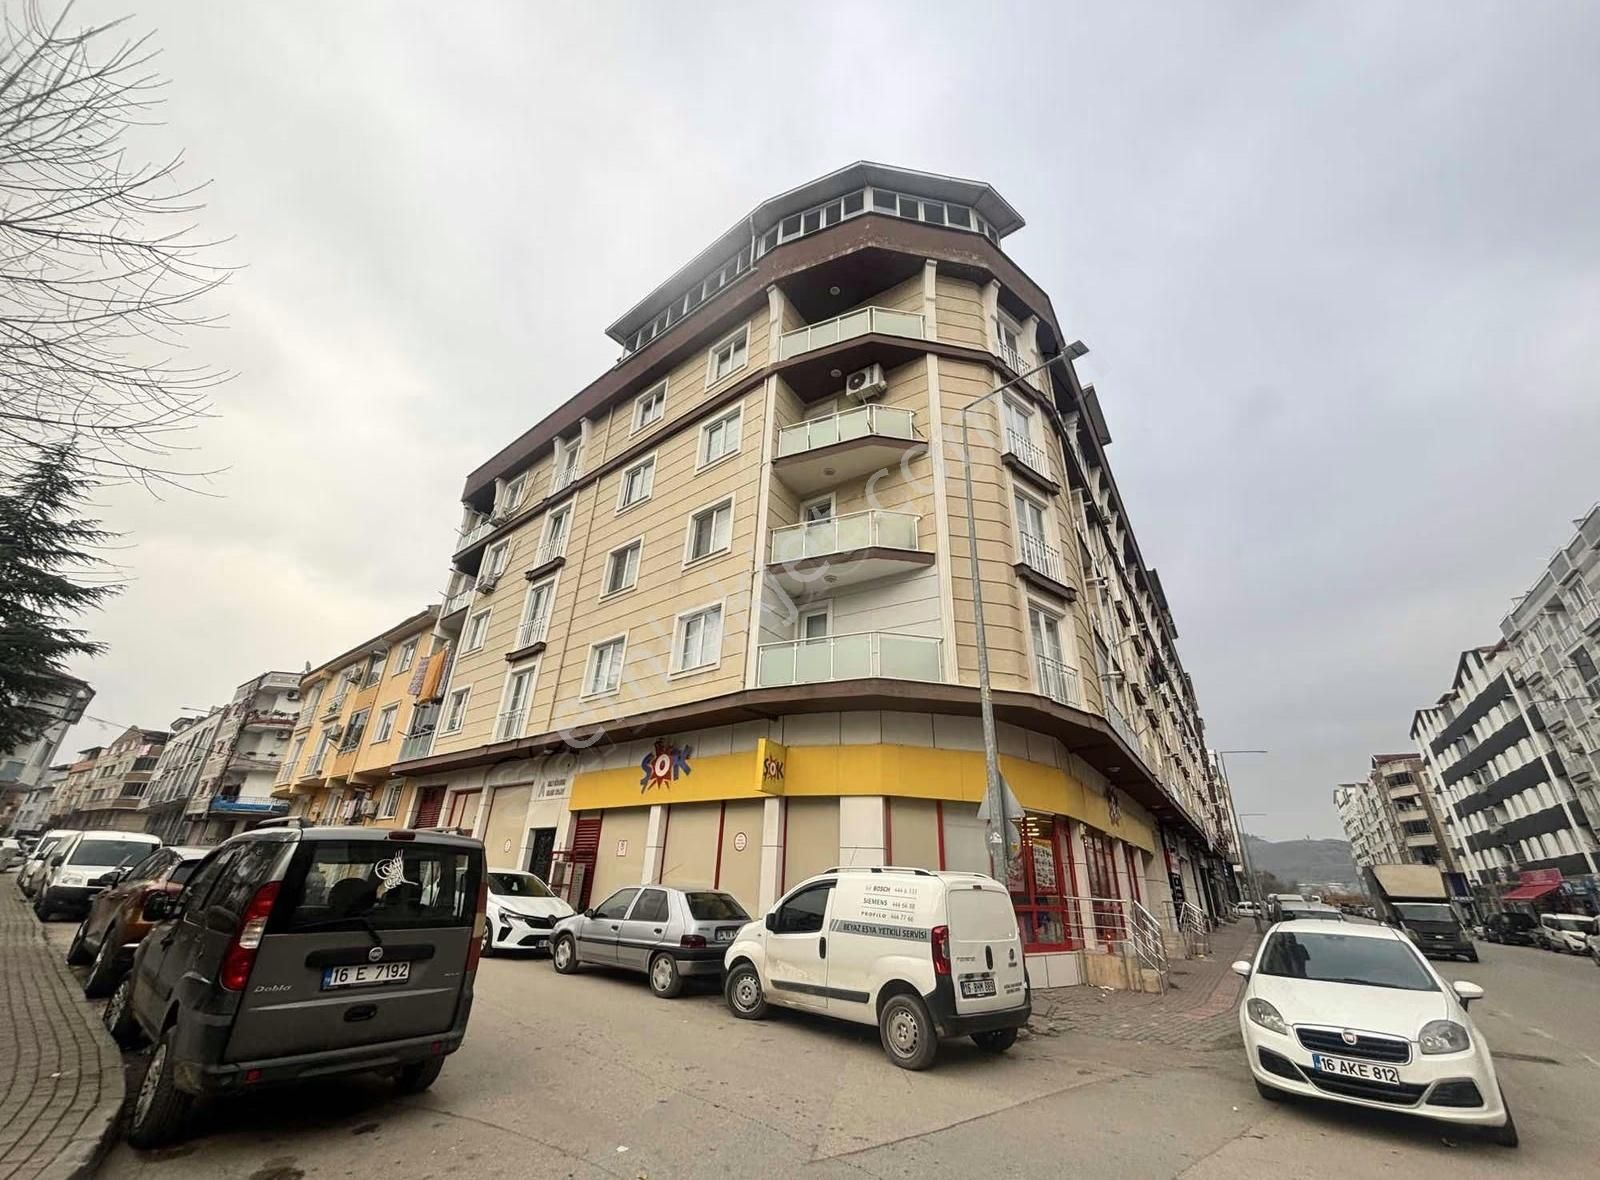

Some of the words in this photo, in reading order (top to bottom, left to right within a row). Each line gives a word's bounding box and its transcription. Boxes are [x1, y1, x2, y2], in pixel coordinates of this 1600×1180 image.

[873, 885, 891, 893] BOSCH
[863, 897, 888, 906] SIEMENS
[334, 968, 348, 983] 16
[356, 966, 368, 981] E
[375, 963, 409, 980] 7192
[1321, 1058, 1336, 1071] 16
[1340, 1061, 1370, 1078] AKE
[1372, 1067, 1397, 1083] 812
